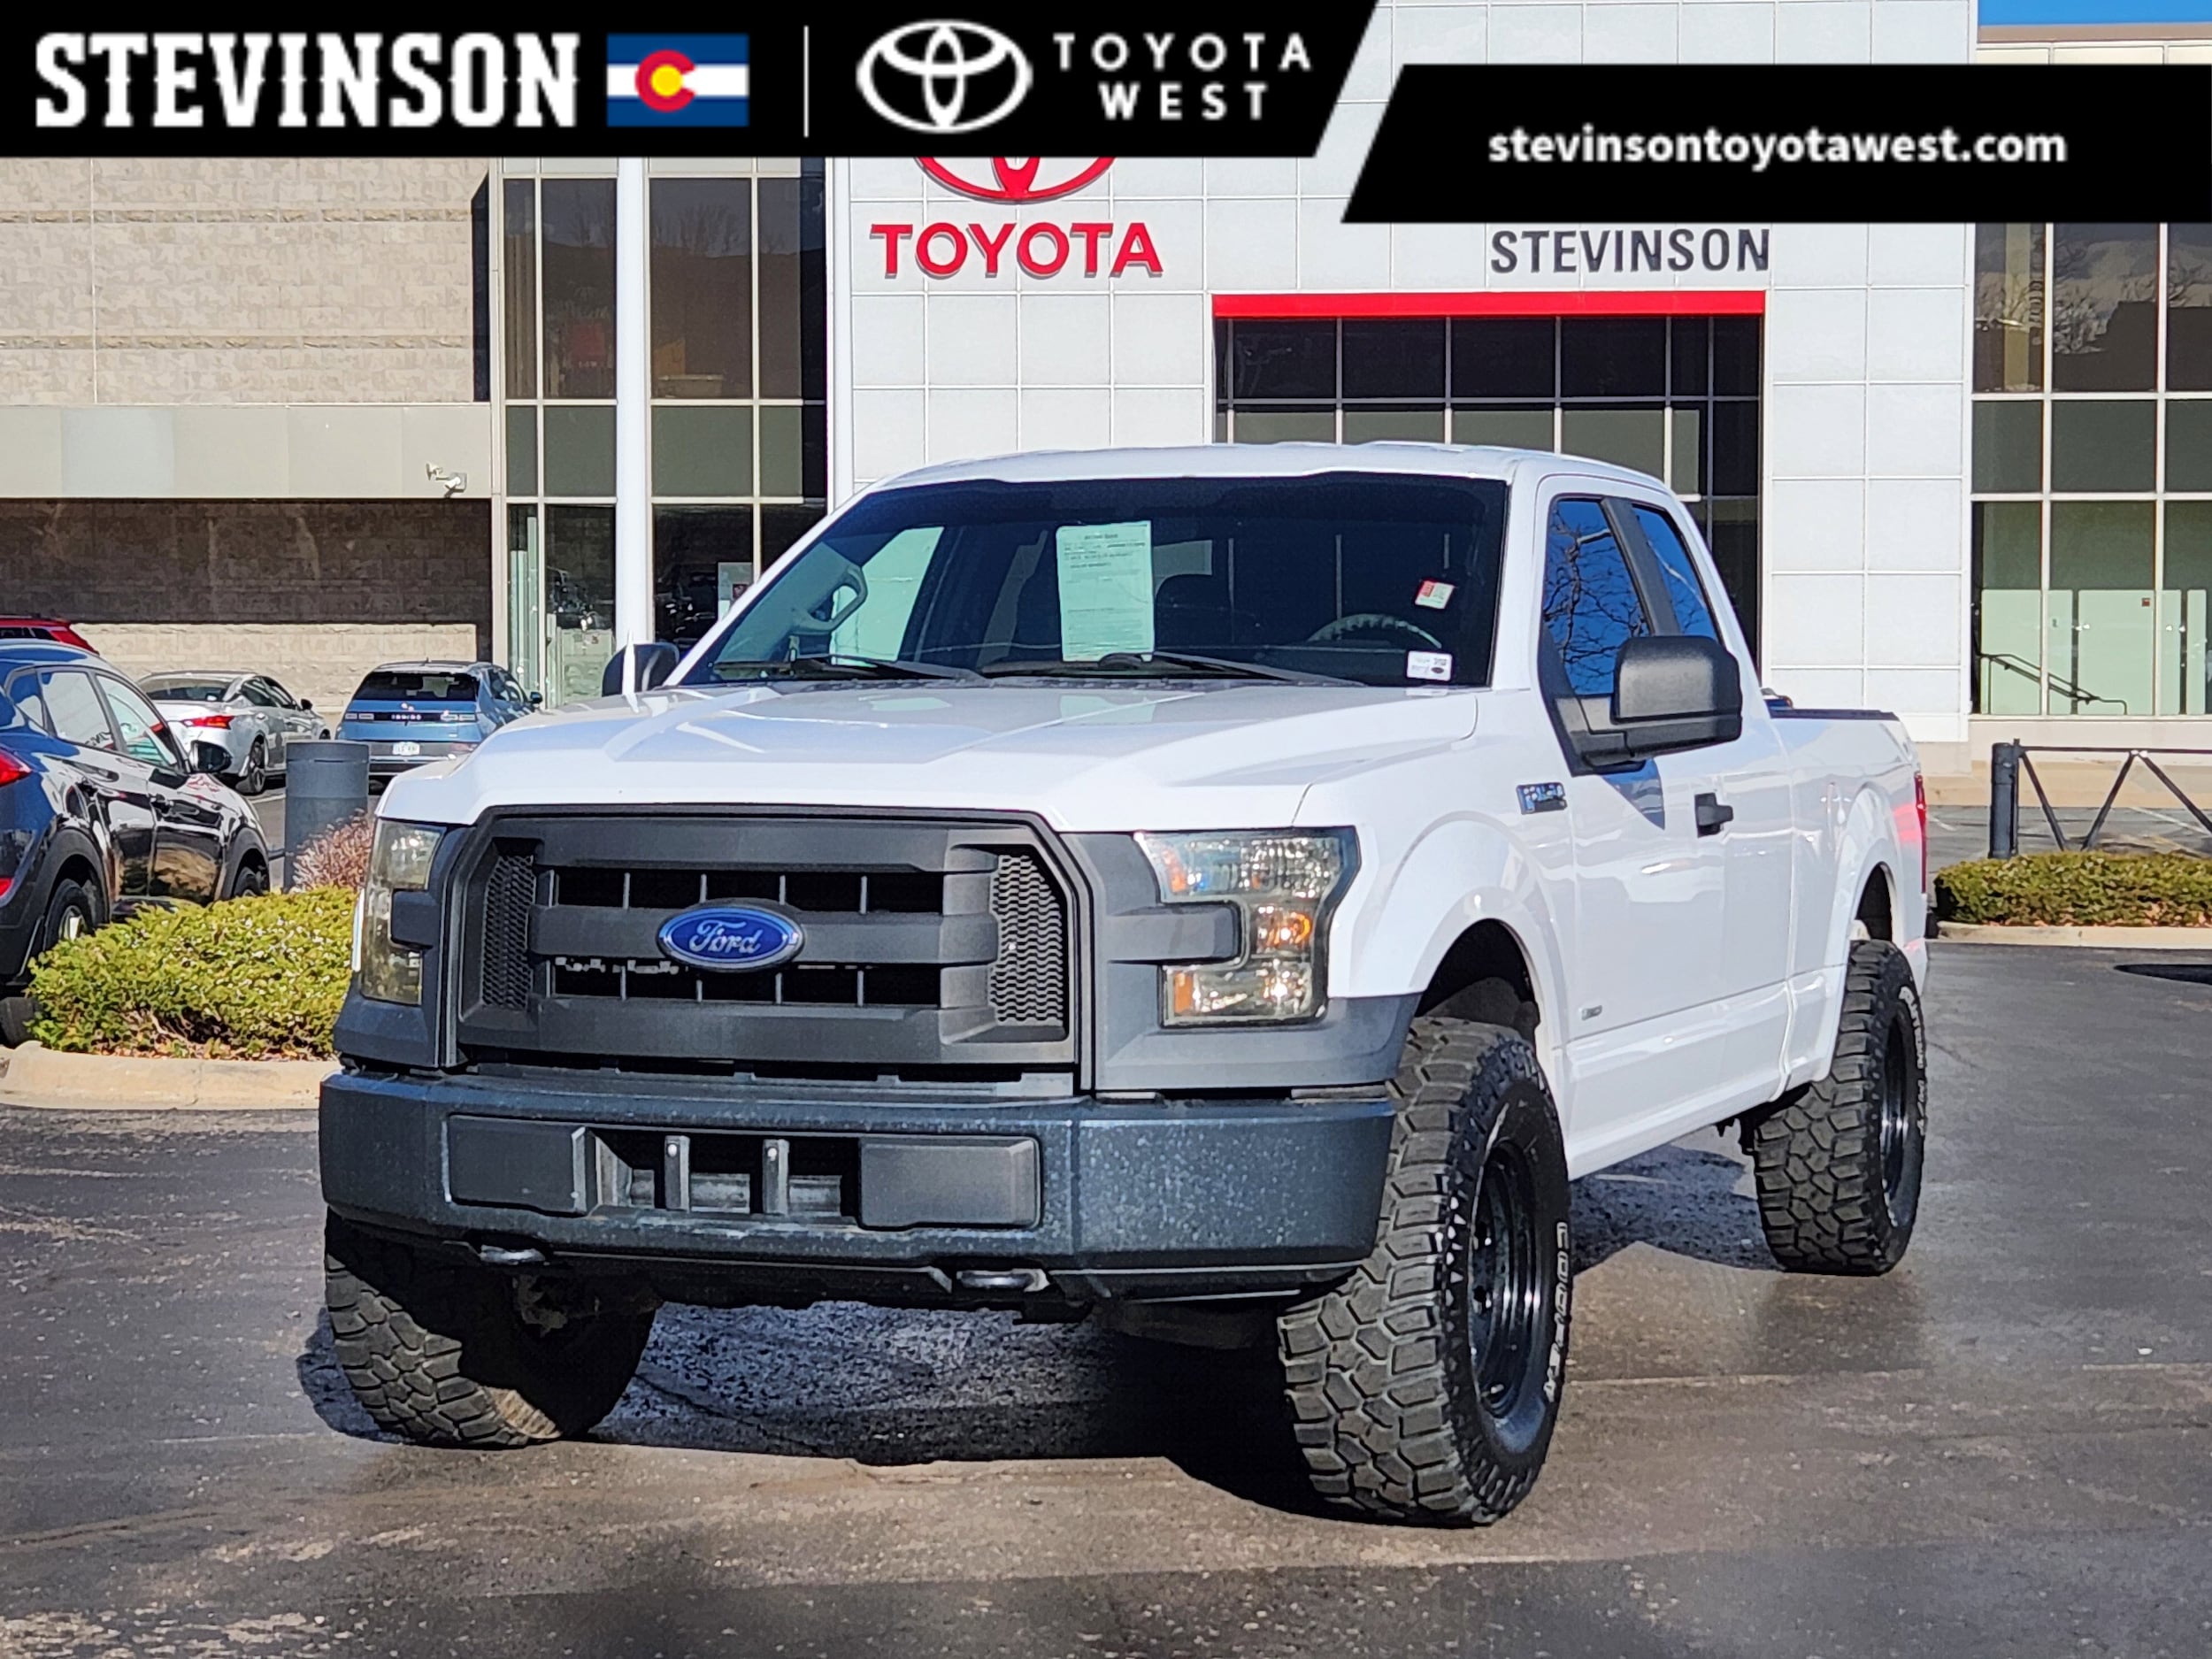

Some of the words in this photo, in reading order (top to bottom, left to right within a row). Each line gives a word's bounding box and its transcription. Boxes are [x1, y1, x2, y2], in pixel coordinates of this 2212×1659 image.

[871, 222, 1164, 278] TOYOTA
[1491, 228, 1770, 273] STEVINSON
[689, 919, 764, 954] Ford
[1543, 1221, 1569, 1402] COOPER
